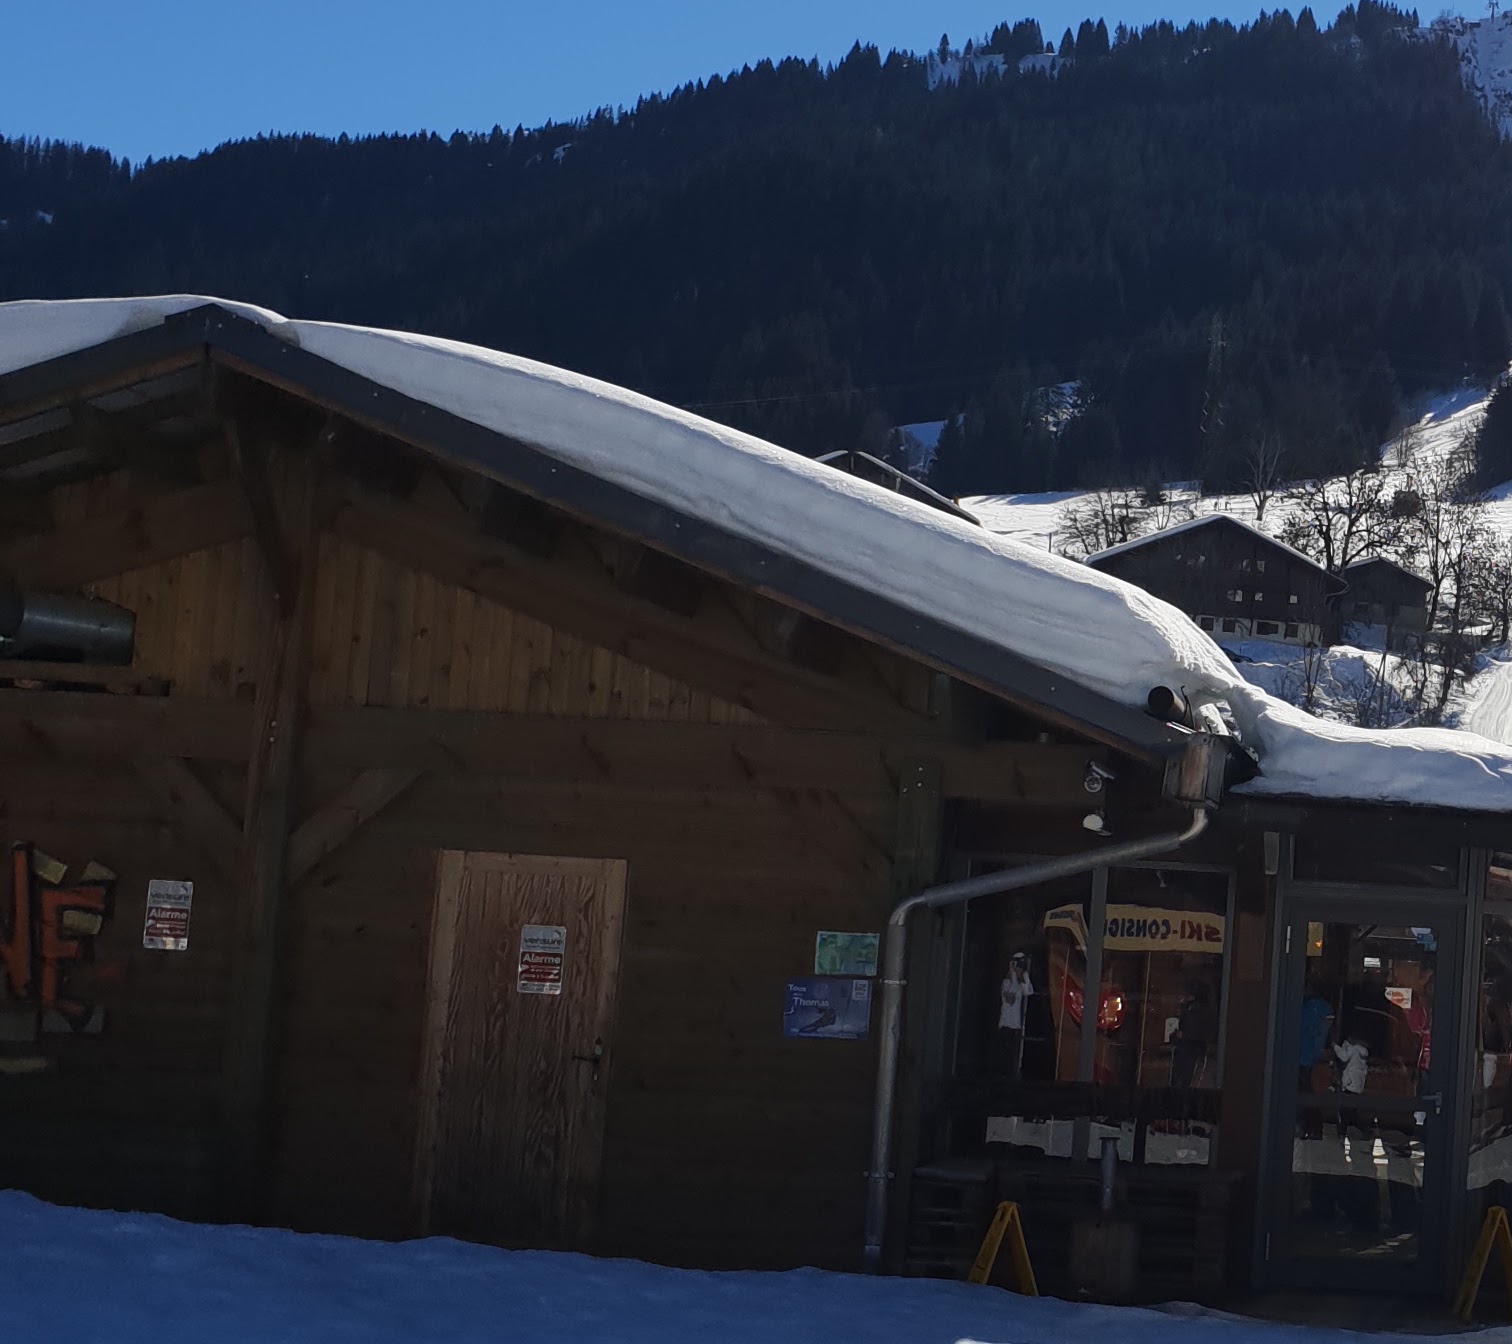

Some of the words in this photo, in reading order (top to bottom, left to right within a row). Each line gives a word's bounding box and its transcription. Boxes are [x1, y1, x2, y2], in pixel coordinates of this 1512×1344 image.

[149, 908, 188, 920] Alarme
[523, 953, 561, 964] Alarme
[793, 997, 829, 1007] Thomas
